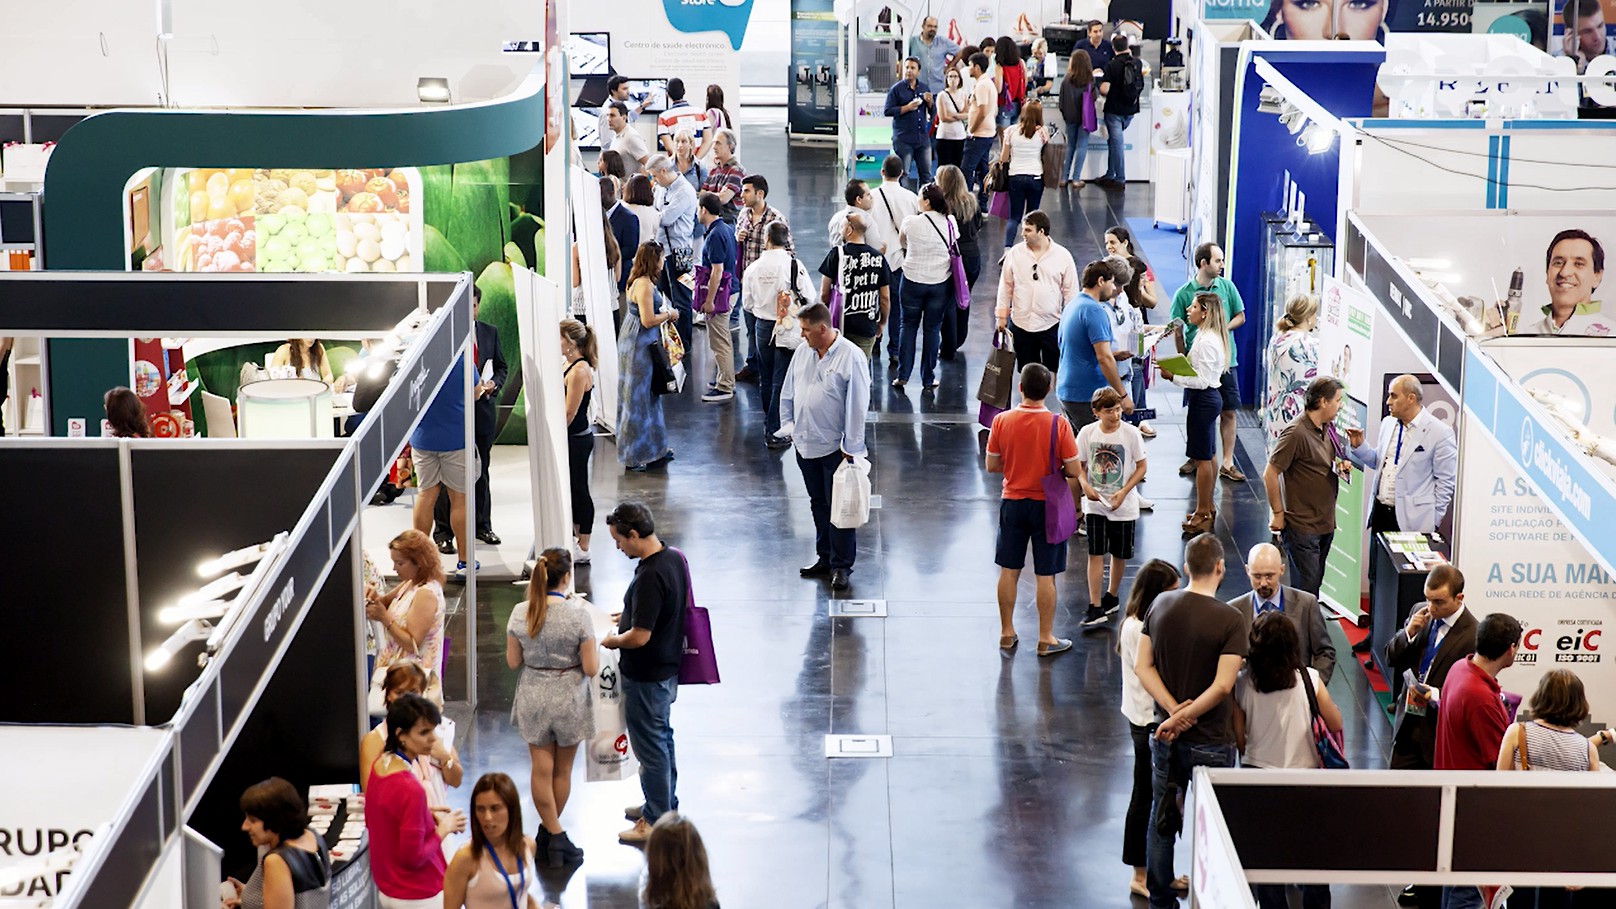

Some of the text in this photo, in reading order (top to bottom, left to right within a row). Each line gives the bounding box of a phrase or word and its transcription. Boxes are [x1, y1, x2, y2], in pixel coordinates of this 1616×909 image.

[1418, 12, 1473, 26] 14.950
[623, 41, 650, 49] Centro
[651, 41, 661, 49] de
[860, 252, 883, 270] Best
[853, 272, 868, 290] yet
[1492, 477, 1507, 496] A
[1491, 505, 1513, 514] SITE
[1489, 532, 1549, 541] SOFTWARE
[1552, 532, 1567, 541] DE
[1487, 562, 1503, 583] A
[1511, 562, 1557, 583] SUA
[1486, 588, 1517, 598] ÚNICA
[1519, 590, 1543, 599] REDE
[1548, 590, 1562, 599] DE
[1565, 589, 1609, 599] AGÊNCIA
[1556, 628, 1602, 652] eiC
[1557, 653, 1598, 662] ISO 9001
